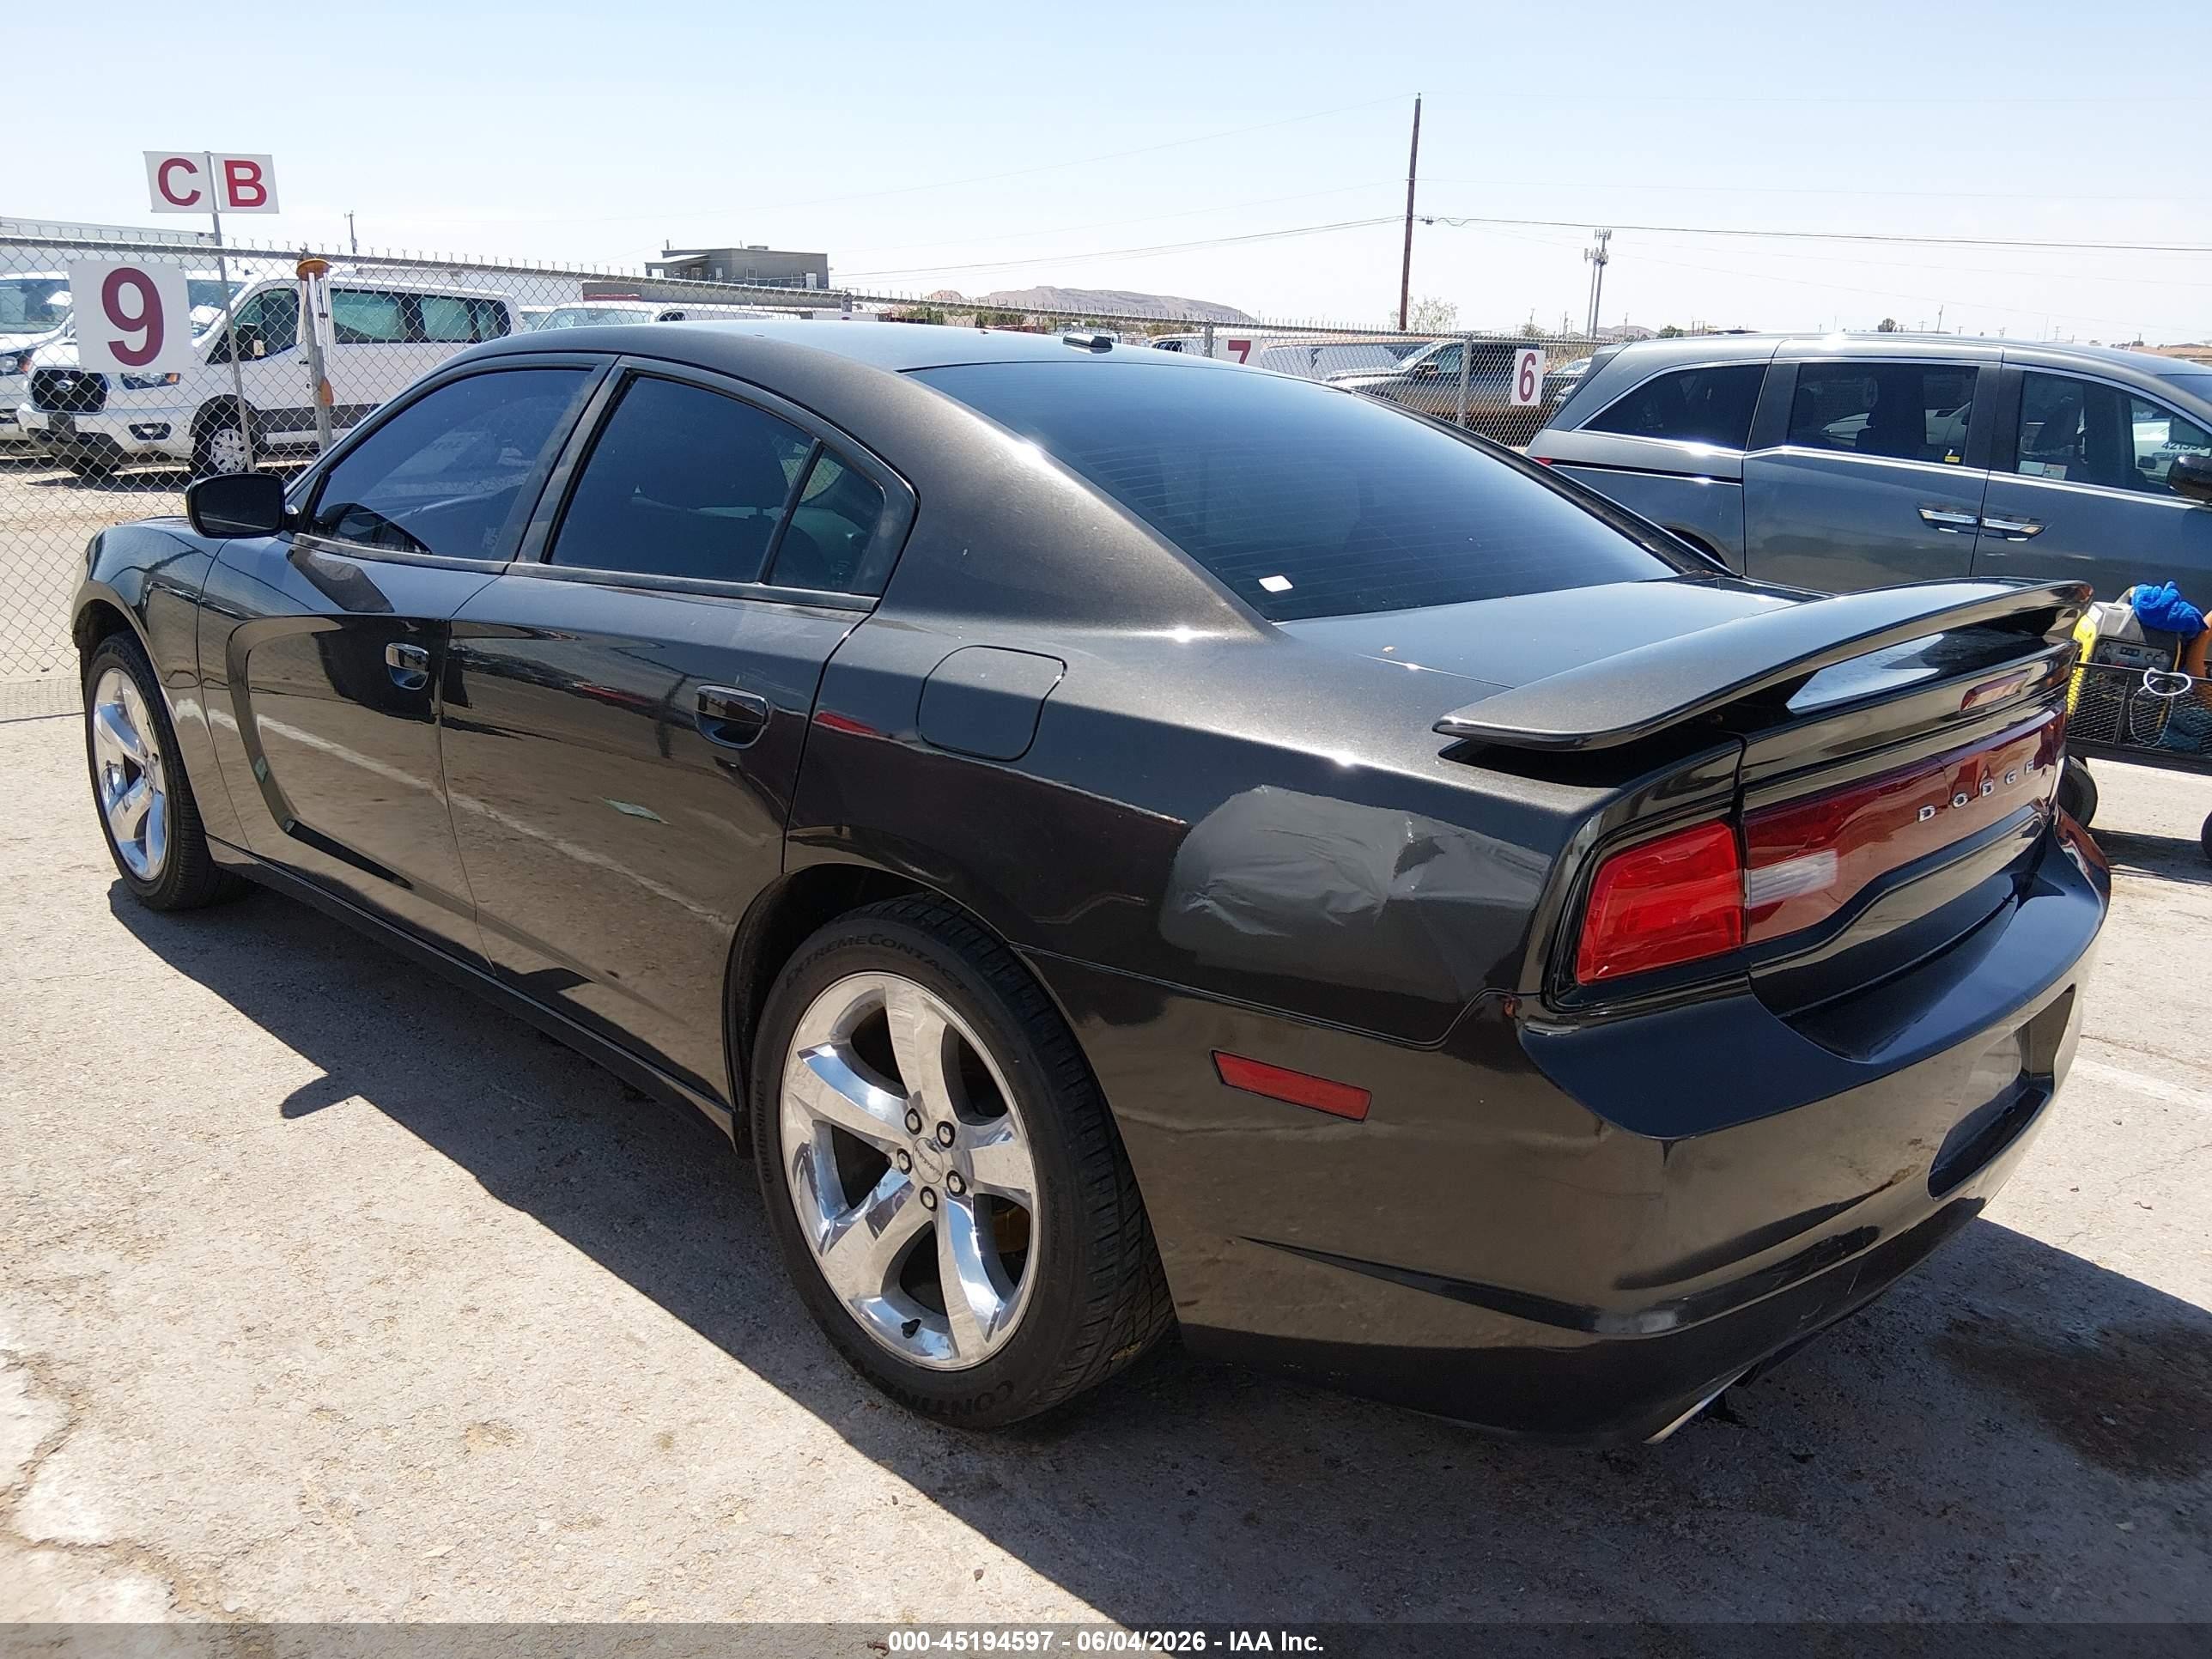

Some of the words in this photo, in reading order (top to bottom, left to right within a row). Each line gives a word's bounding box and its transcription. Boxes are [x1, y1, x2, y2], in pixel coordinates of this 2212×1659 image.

[157, 157, 202, 207] C
[224, 160, 268, 207] B
[101, 267, 165, 367] 9
[1228, 339, 1251, 364] 7
[1518, 352, 1537, 403] 6
[1917, 759, 2034, 823] DODGE
